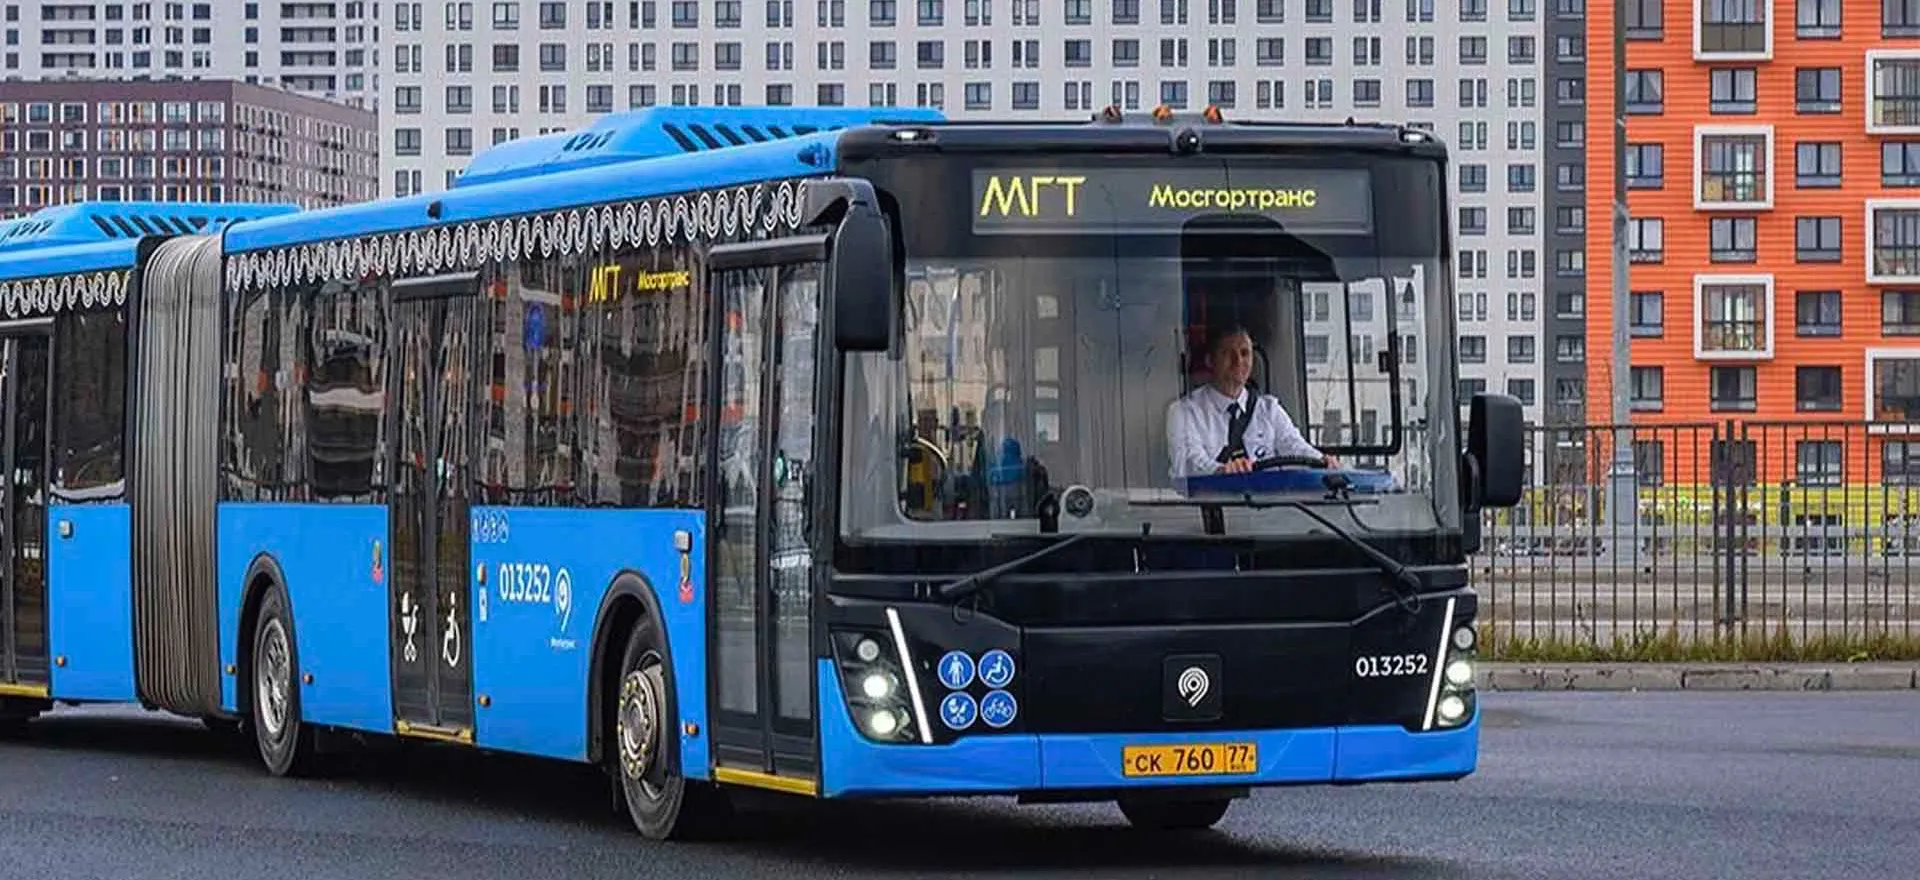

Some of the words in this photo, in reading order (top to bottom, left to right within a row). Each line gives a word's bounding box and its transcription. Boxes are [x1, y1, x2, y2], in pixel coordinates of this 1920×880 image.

[980, 176, 1086, 217] МГТ
[1148, 184, 1317, 211] Мосгортранс
[588, 264, 621, 303] МГТ
[499, 562, 551, 603] 013252
[1355, 653, 1428, 678] 013252
[1173, 747, 1215, 772] 760
[1228, 745, 1249, 764] 77
